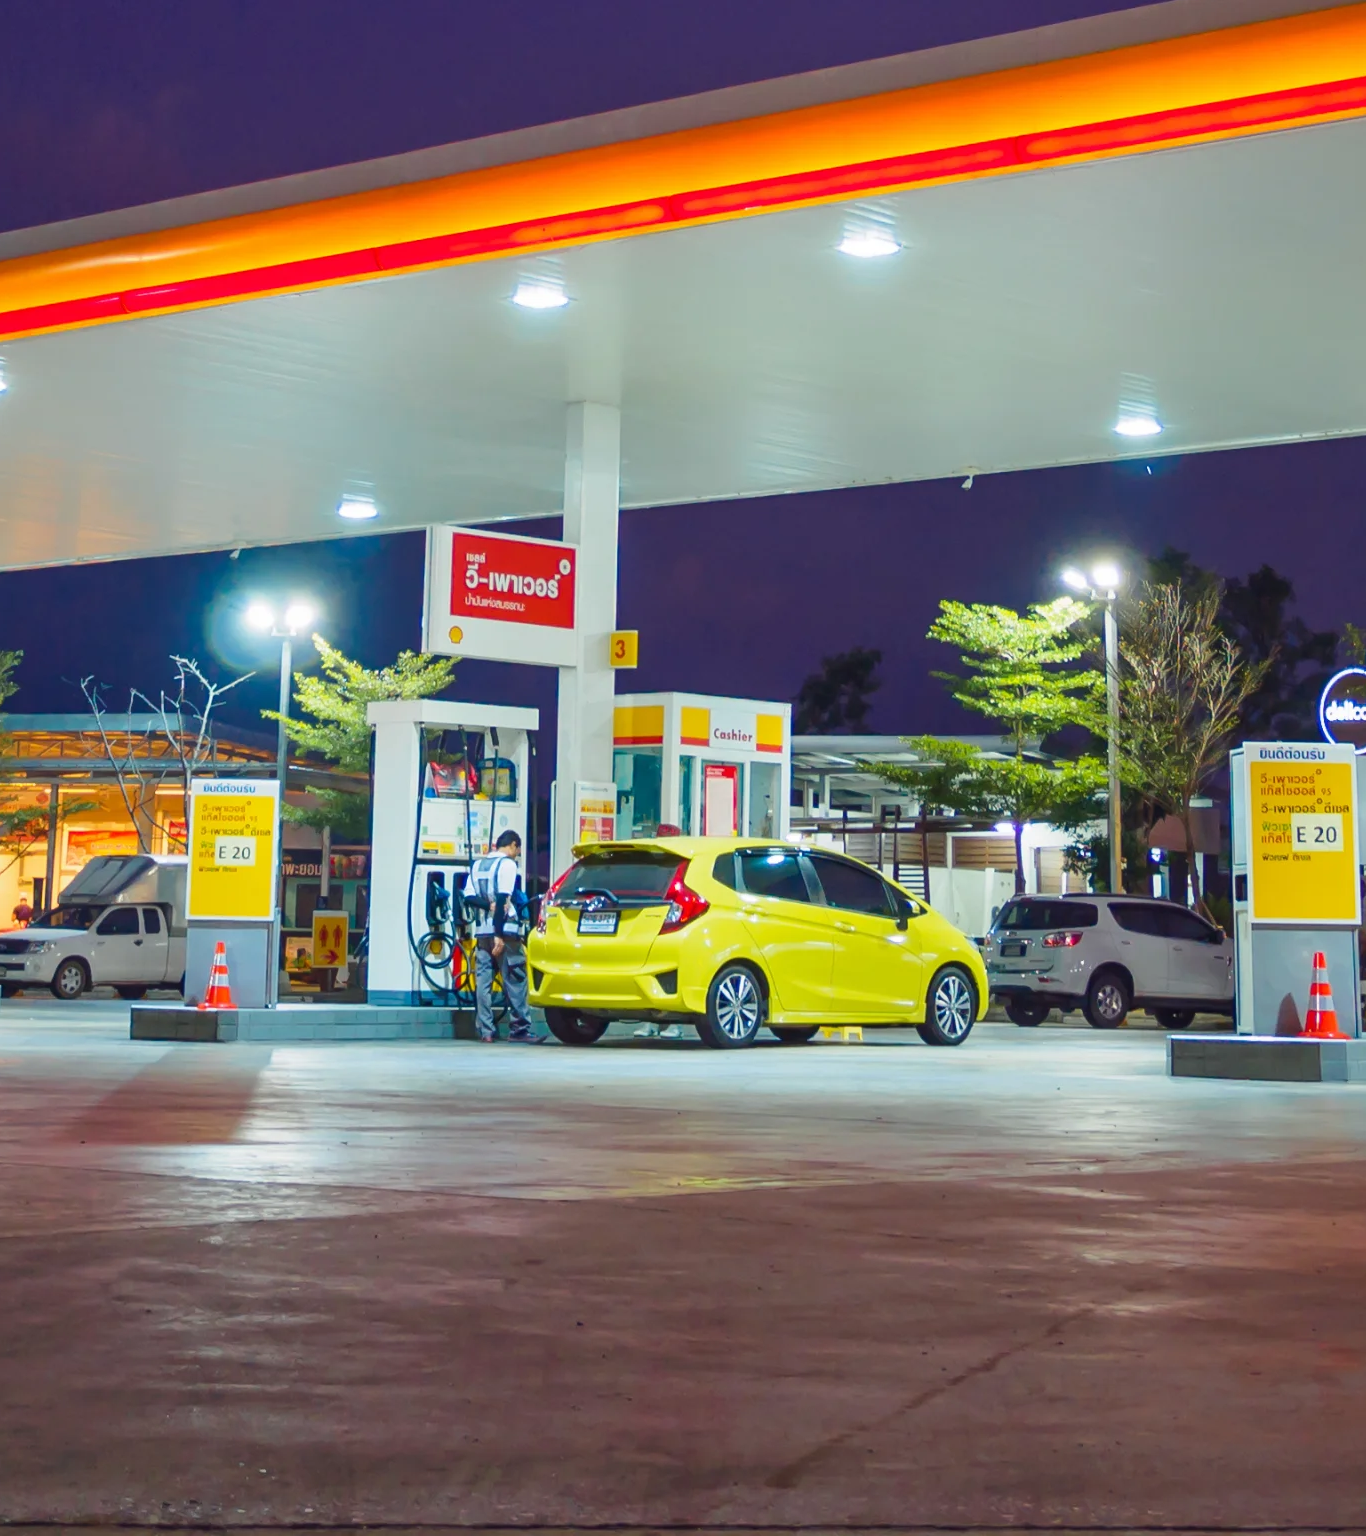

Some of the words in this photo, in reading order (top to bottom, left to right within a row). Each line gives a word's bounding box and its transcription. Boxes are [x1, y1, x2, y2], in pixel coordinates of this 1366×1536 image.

[465, 563, 561, 599] วี-เพาเวอร์
[614, 639, 626, 659] 3
[713, 728, 753, 742] Cashier
[1259, 746, 1326, 760] ยินดีต้อนรับ
[1296, 826, 1307, 843] E
[1314, 826, 1337, 843] 20
[218, 846, 227, 859] E
[232, 846, 251, 860] 20
